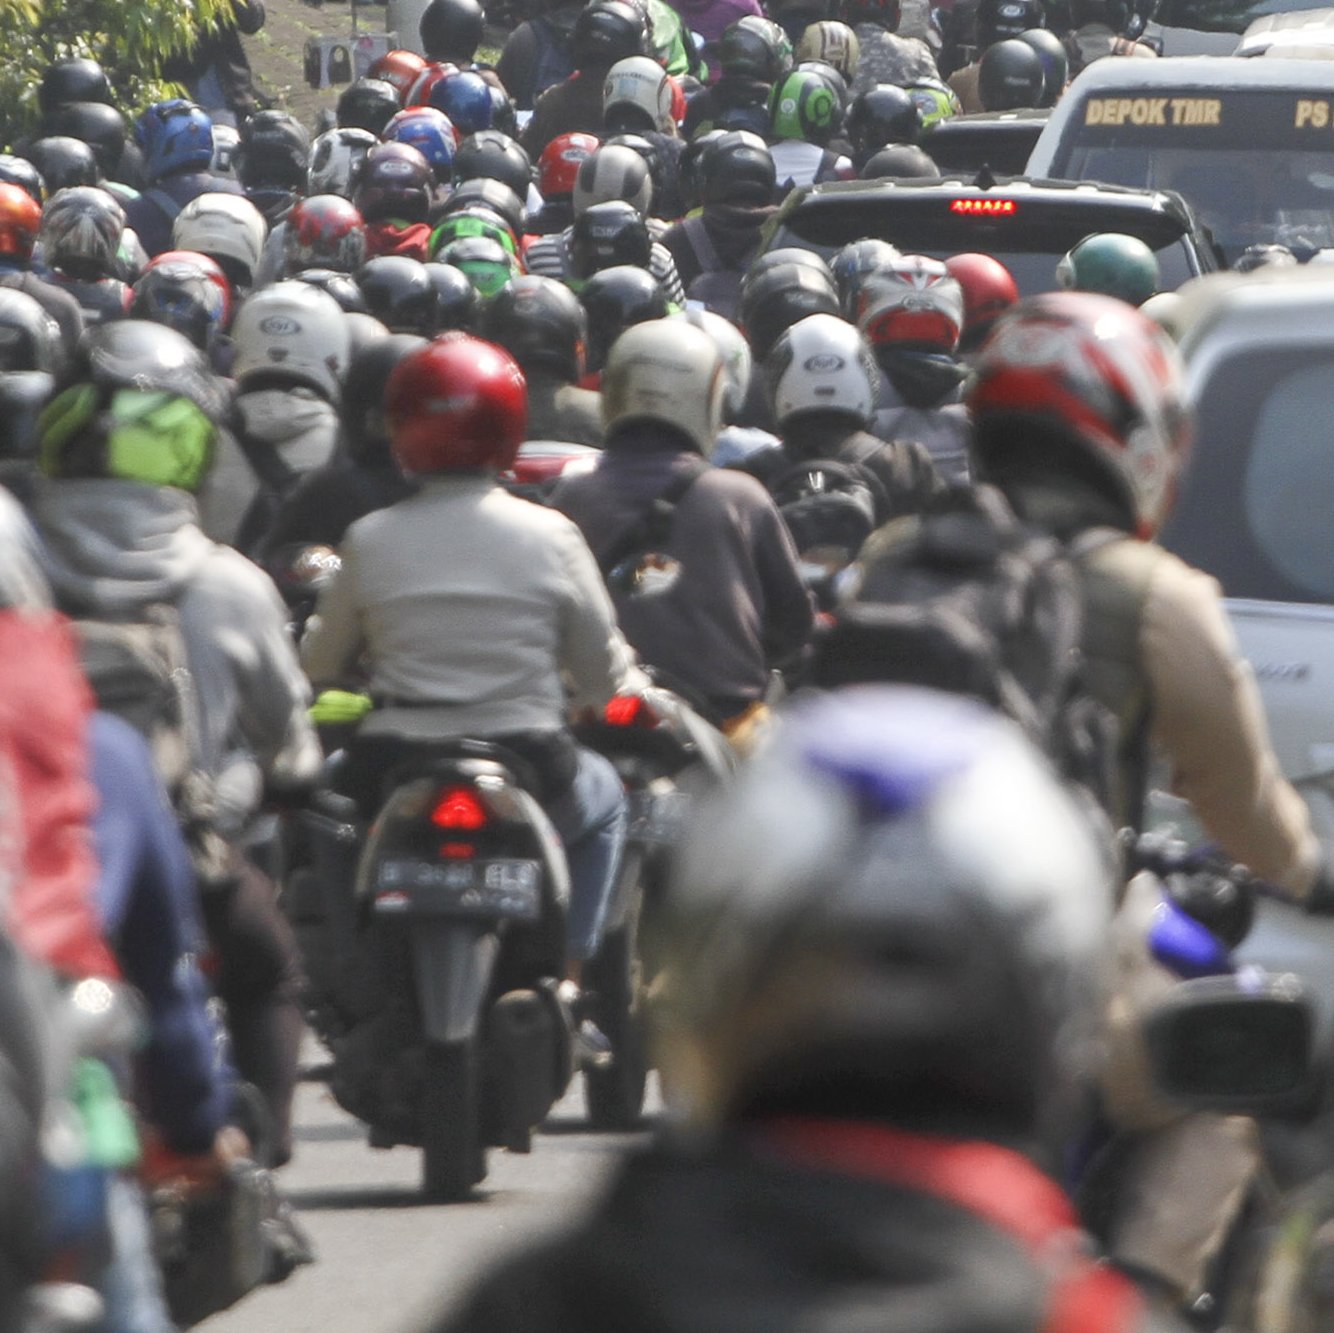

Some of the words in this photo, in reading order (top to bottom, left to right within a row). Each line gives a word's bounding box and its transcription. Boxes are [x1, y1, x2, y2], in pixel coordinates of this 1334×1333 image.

[1085, 98, 1168, 126] DEPOK
[1170, 98, 1221, 125] TMR
[1294, 100, 1329, 128] PS
